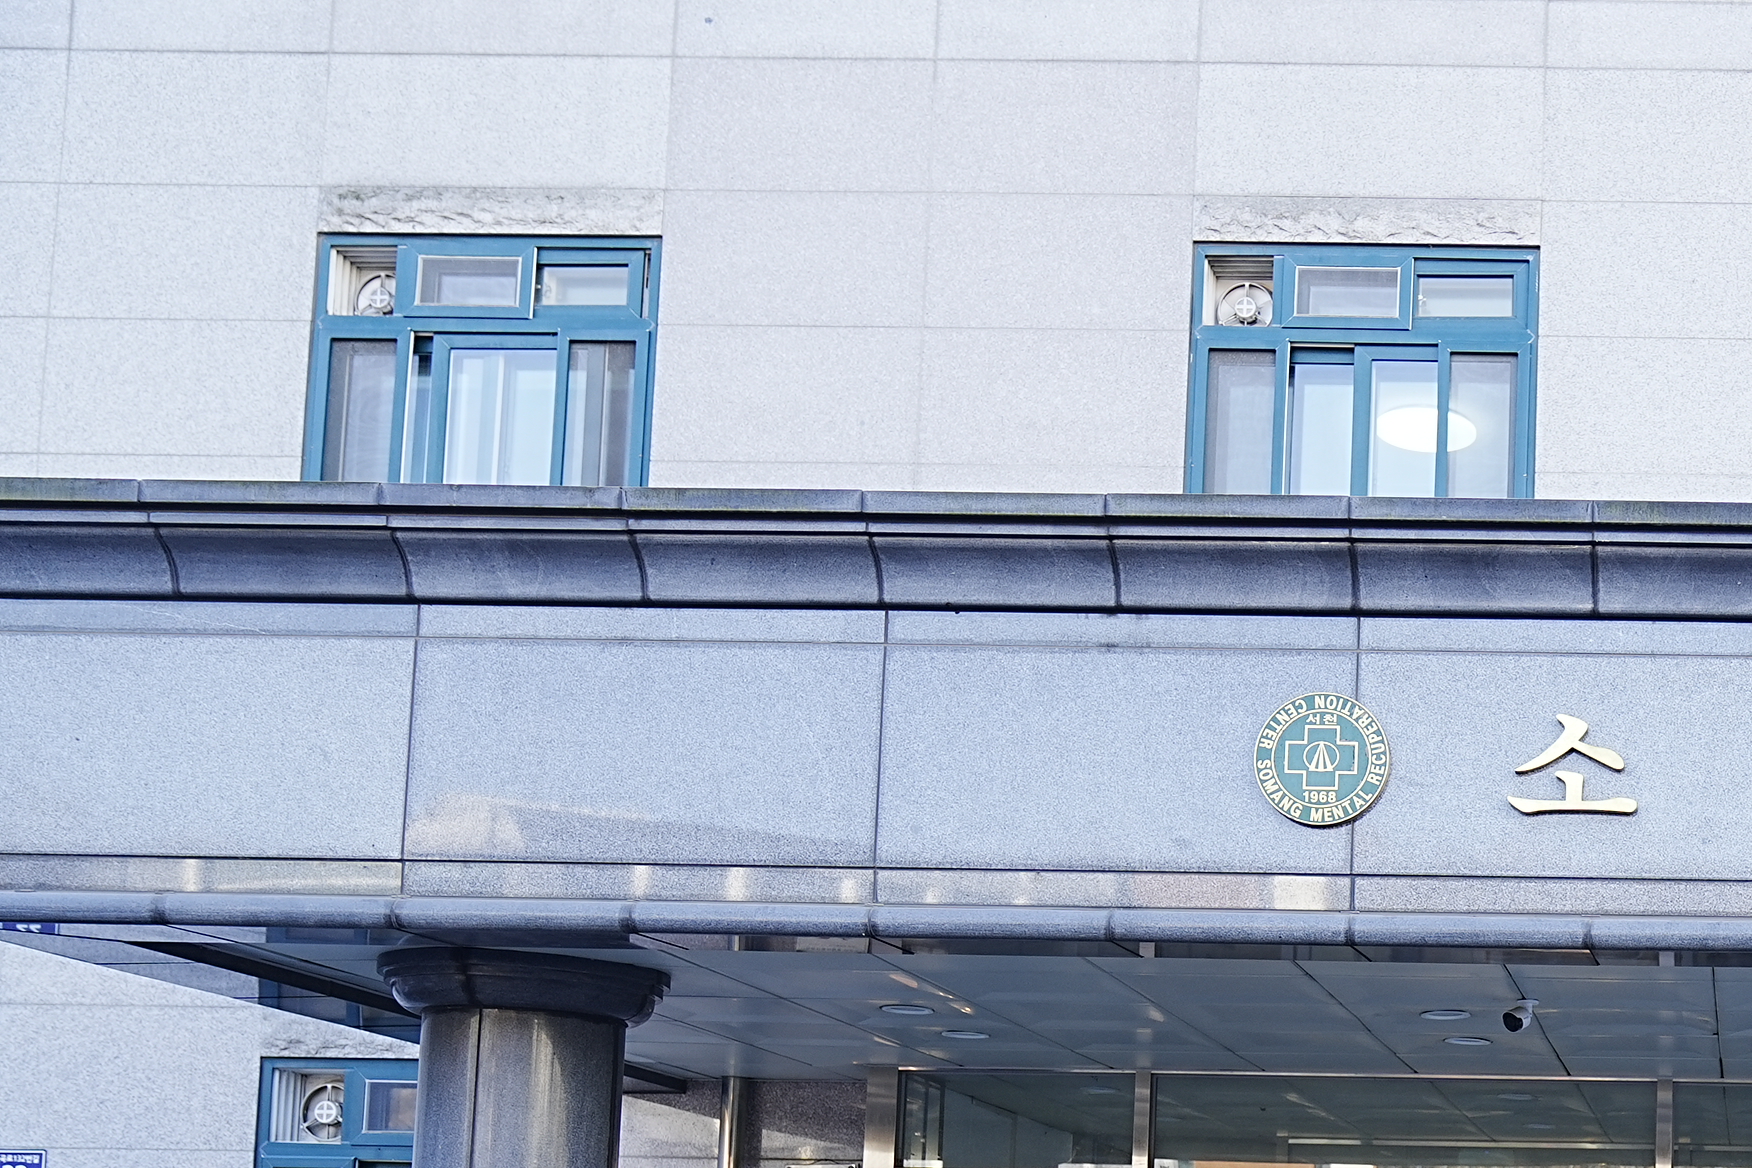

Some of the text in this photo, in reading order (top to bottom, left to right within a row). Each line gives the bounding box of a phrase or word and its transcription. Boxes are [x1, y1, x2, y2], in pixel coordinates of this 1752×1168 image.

[1257, 695, 1386, 822] SOMANG MENTAL RECUPERATION CENTER
[1303, 790, 1337, 803] 1968
